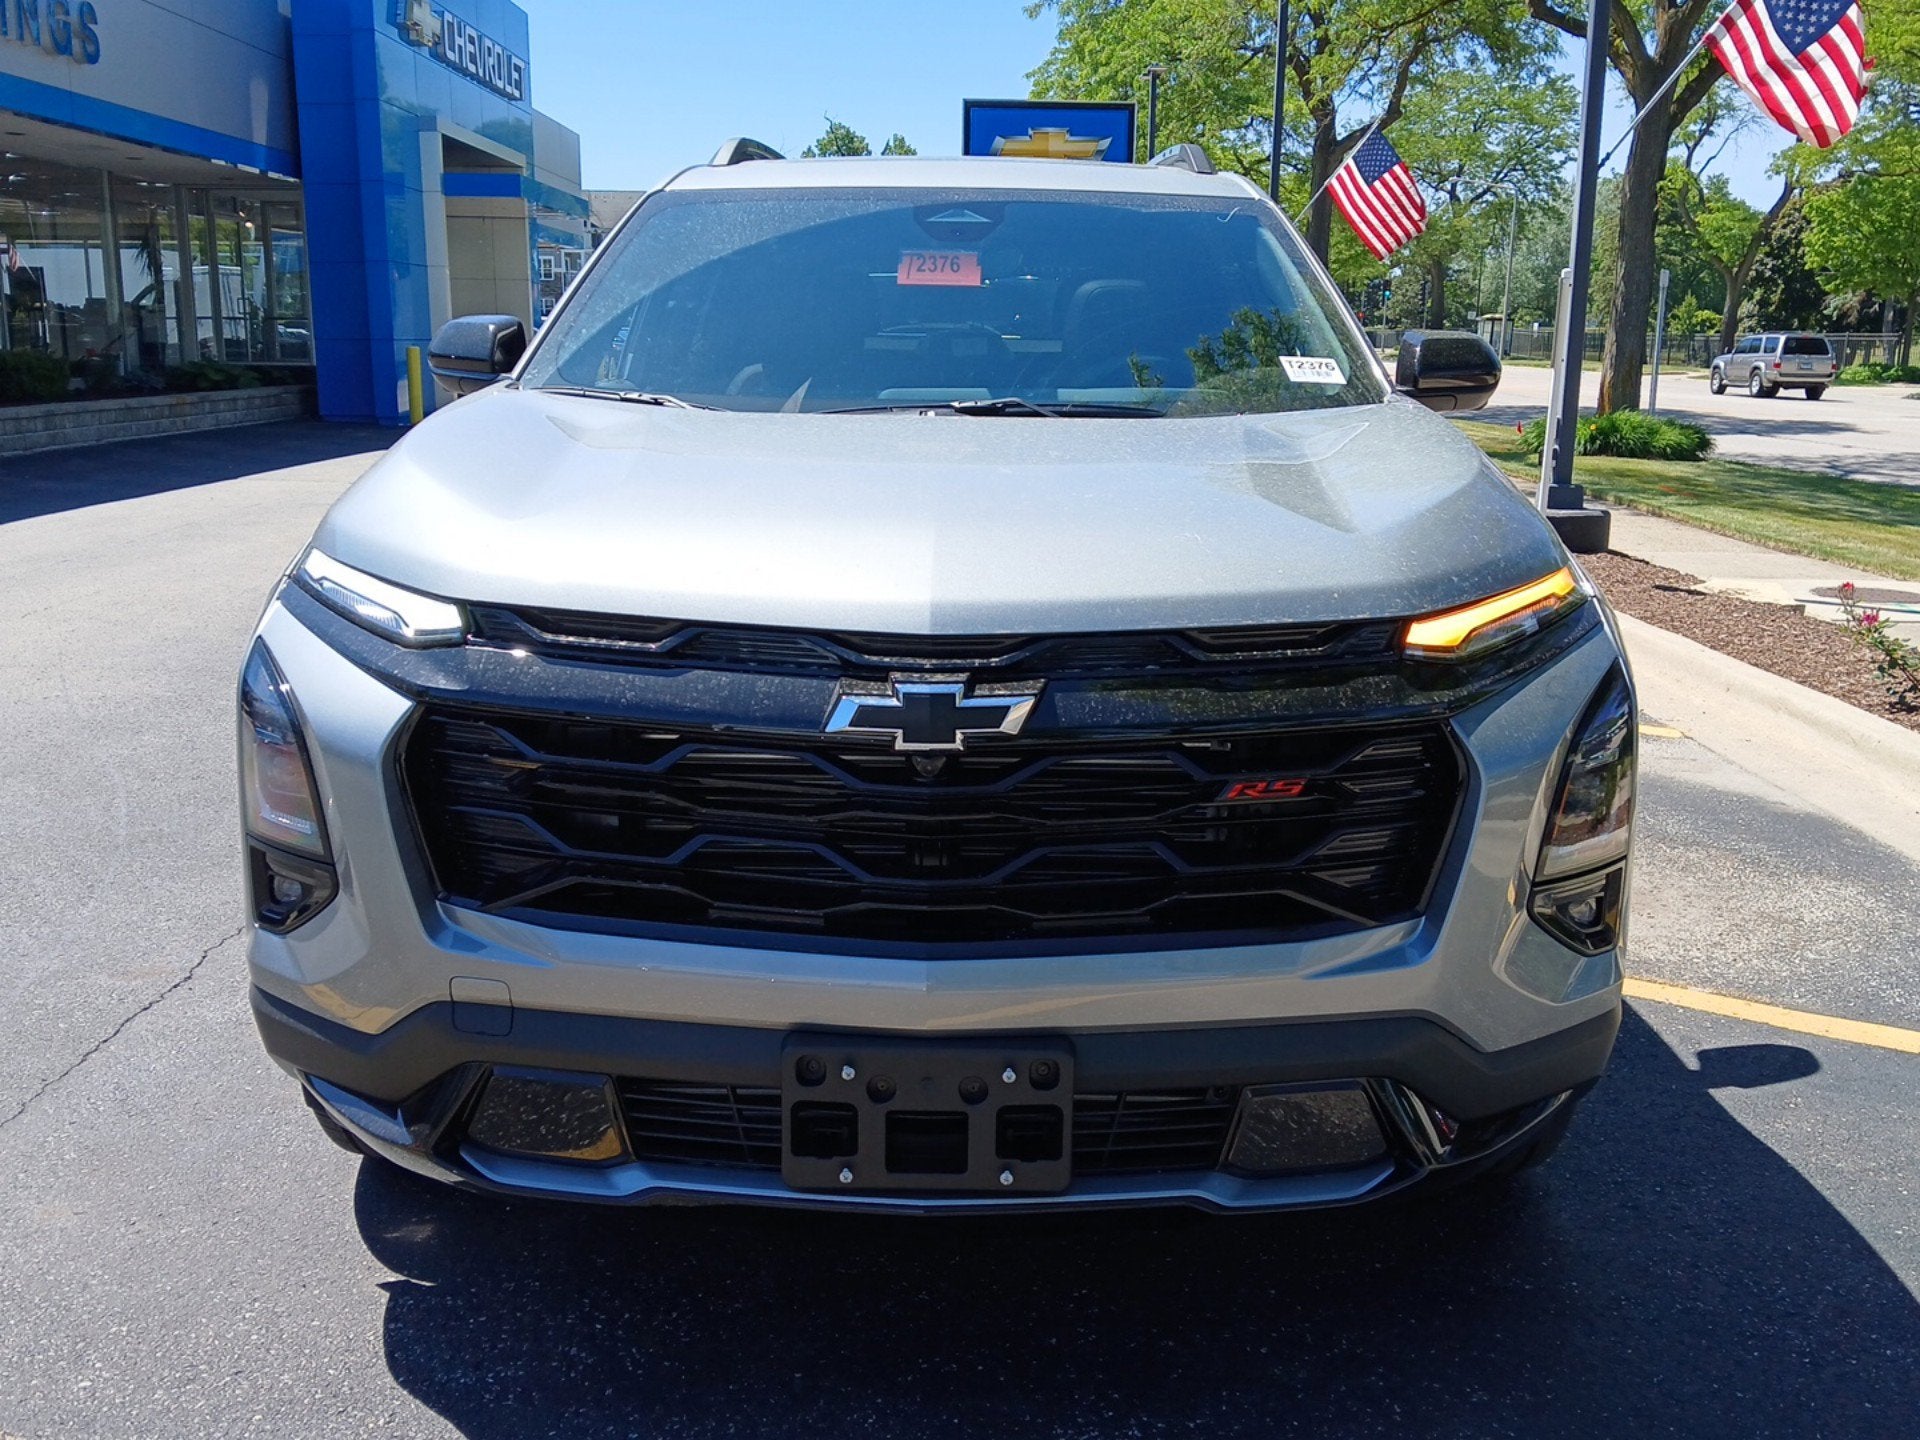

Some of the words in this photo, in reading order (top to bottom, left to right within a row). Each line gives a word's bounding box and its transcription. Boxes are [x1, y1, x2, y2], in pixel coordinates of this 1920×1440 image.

[443, 11, 525, 101] CHEVROLET
[1285, 359, 1336, 372] T2376
[1226, 779, 1308, 800] RS
